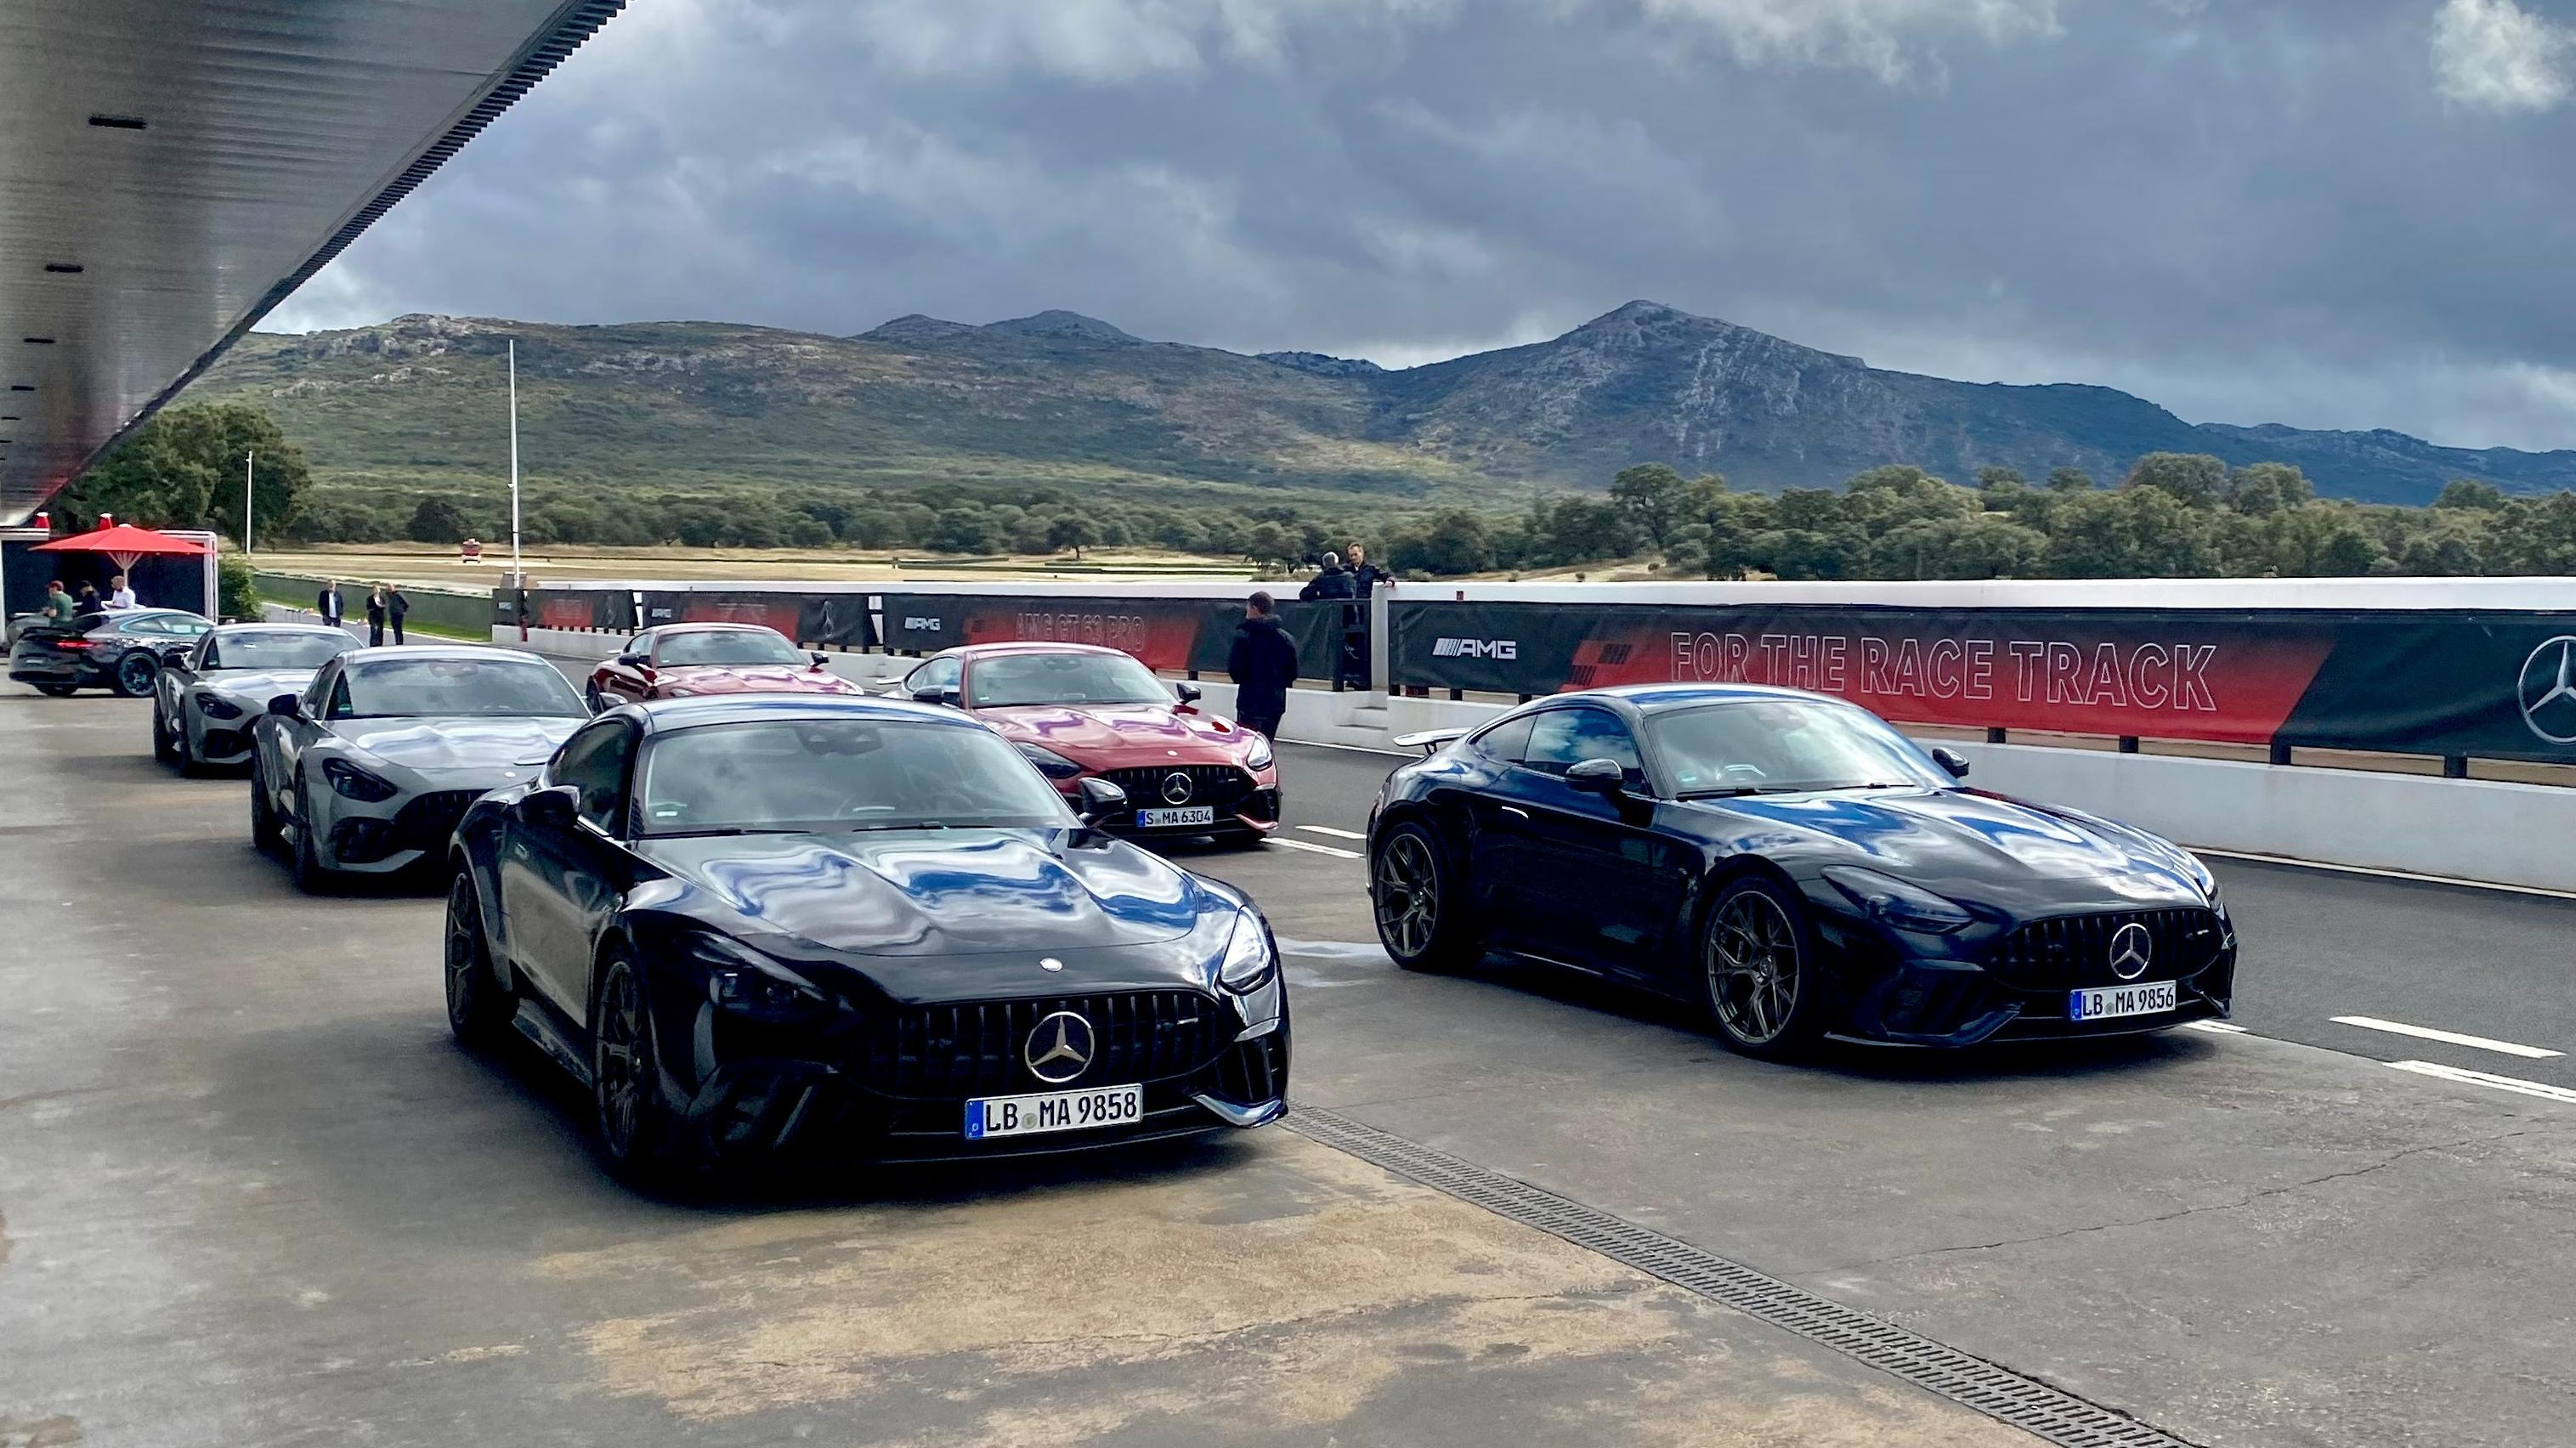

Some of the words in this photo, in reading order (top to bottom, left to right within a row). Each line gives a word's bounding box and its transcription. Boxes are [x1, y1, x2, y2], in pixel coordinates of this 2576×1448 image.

[915, 618, 941, 631] AMG
[1456, 638, 1516, 659] AMG
[1671, 632, 1749, 682] FOR
[1760, 634, 1847, 692] THE
[1861, 637, 1994, 699] RACE
[2009, 641, 2216, 712] TRACK
[1146, 812, 1154, 824] S
[1162, 811, 1179, 824] MA
[1181, 810, 1210, 823] 6304
[2083, 993, 2103, 1015] LB
[2115, 991, 2135, 1013] MA
[2138, 987, 2174, 1010] 9856
[986, 1102, 1018, 1132] LB
[1039, 1098, 1072, 1128] MA
[1079, 1091, 1137, 1123] 9858
